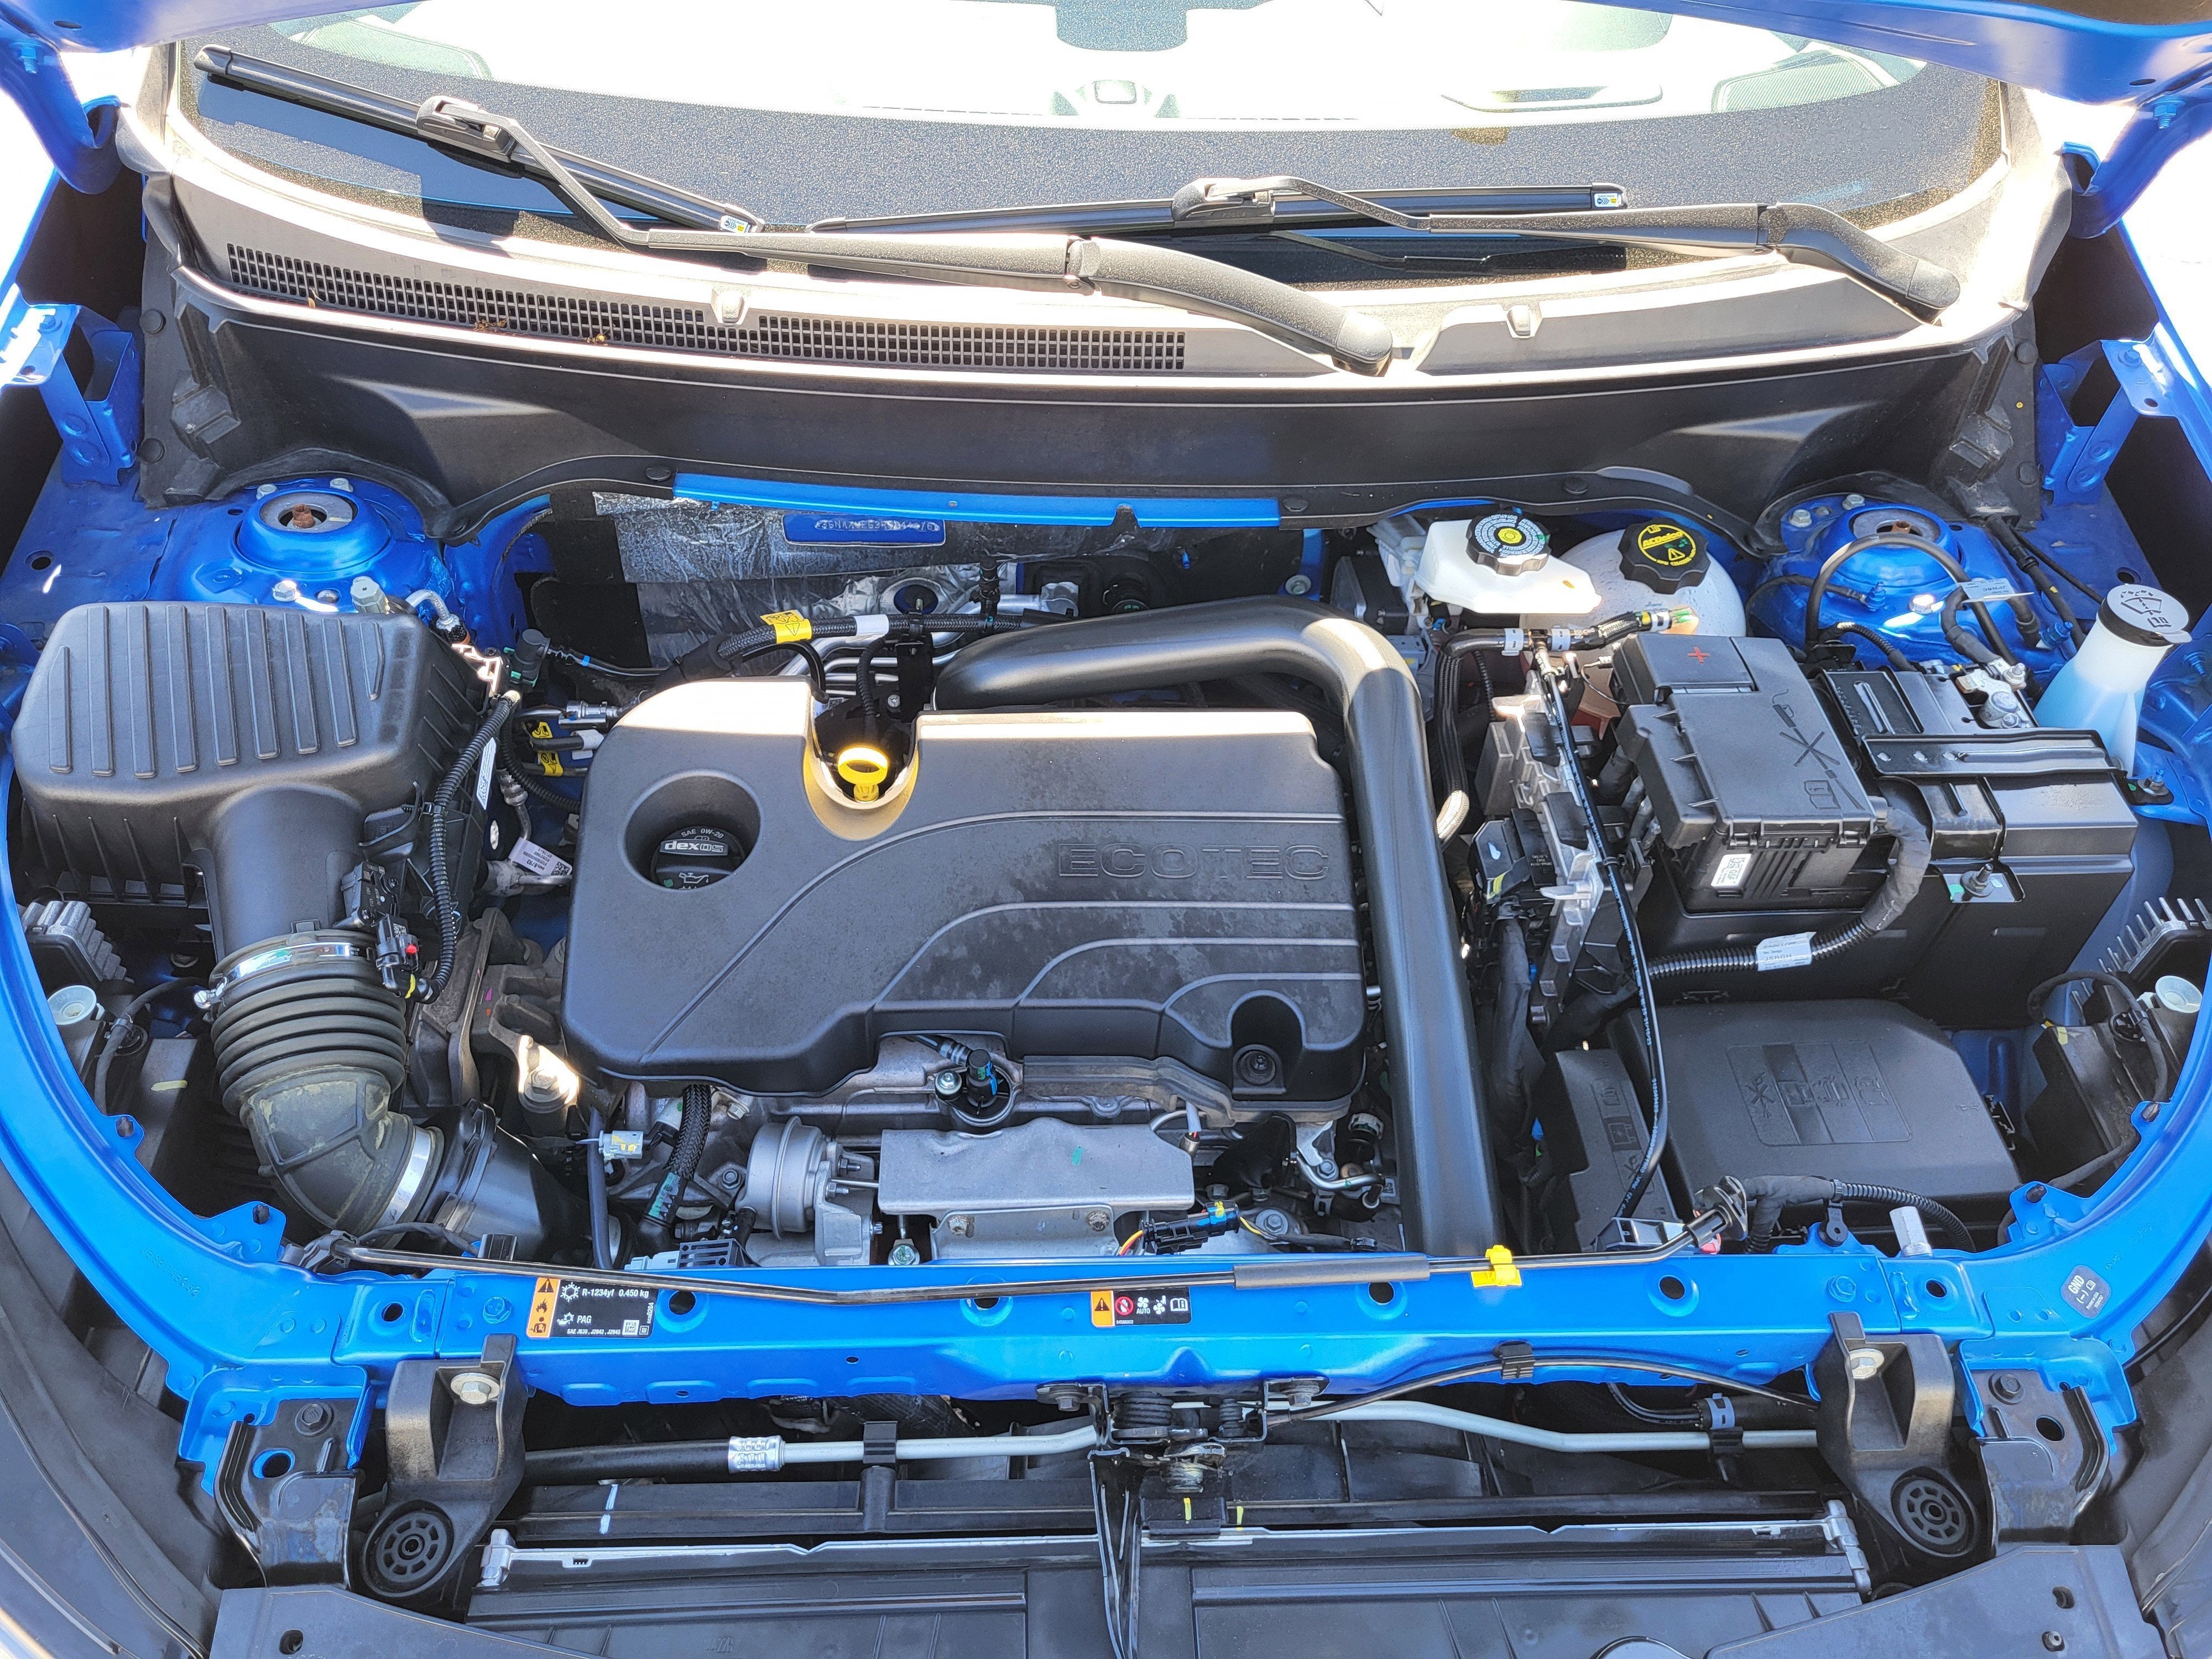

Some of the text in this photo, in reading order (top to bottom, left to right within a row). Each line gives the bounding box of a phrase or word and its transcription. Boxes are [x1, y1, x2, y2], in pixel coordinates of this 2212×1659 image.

[681, 828, 724, 839] SAE 0W-20
[665, 841, 724, 853] dexos
[1058, 843, 1329, 880] ECOTEC
[2068, 1275, 2084, 1294] GND
[582, 1288, 649, 1298] R-1234yf 0.450 kg
[577, 1315, 592, 1323] PAG
